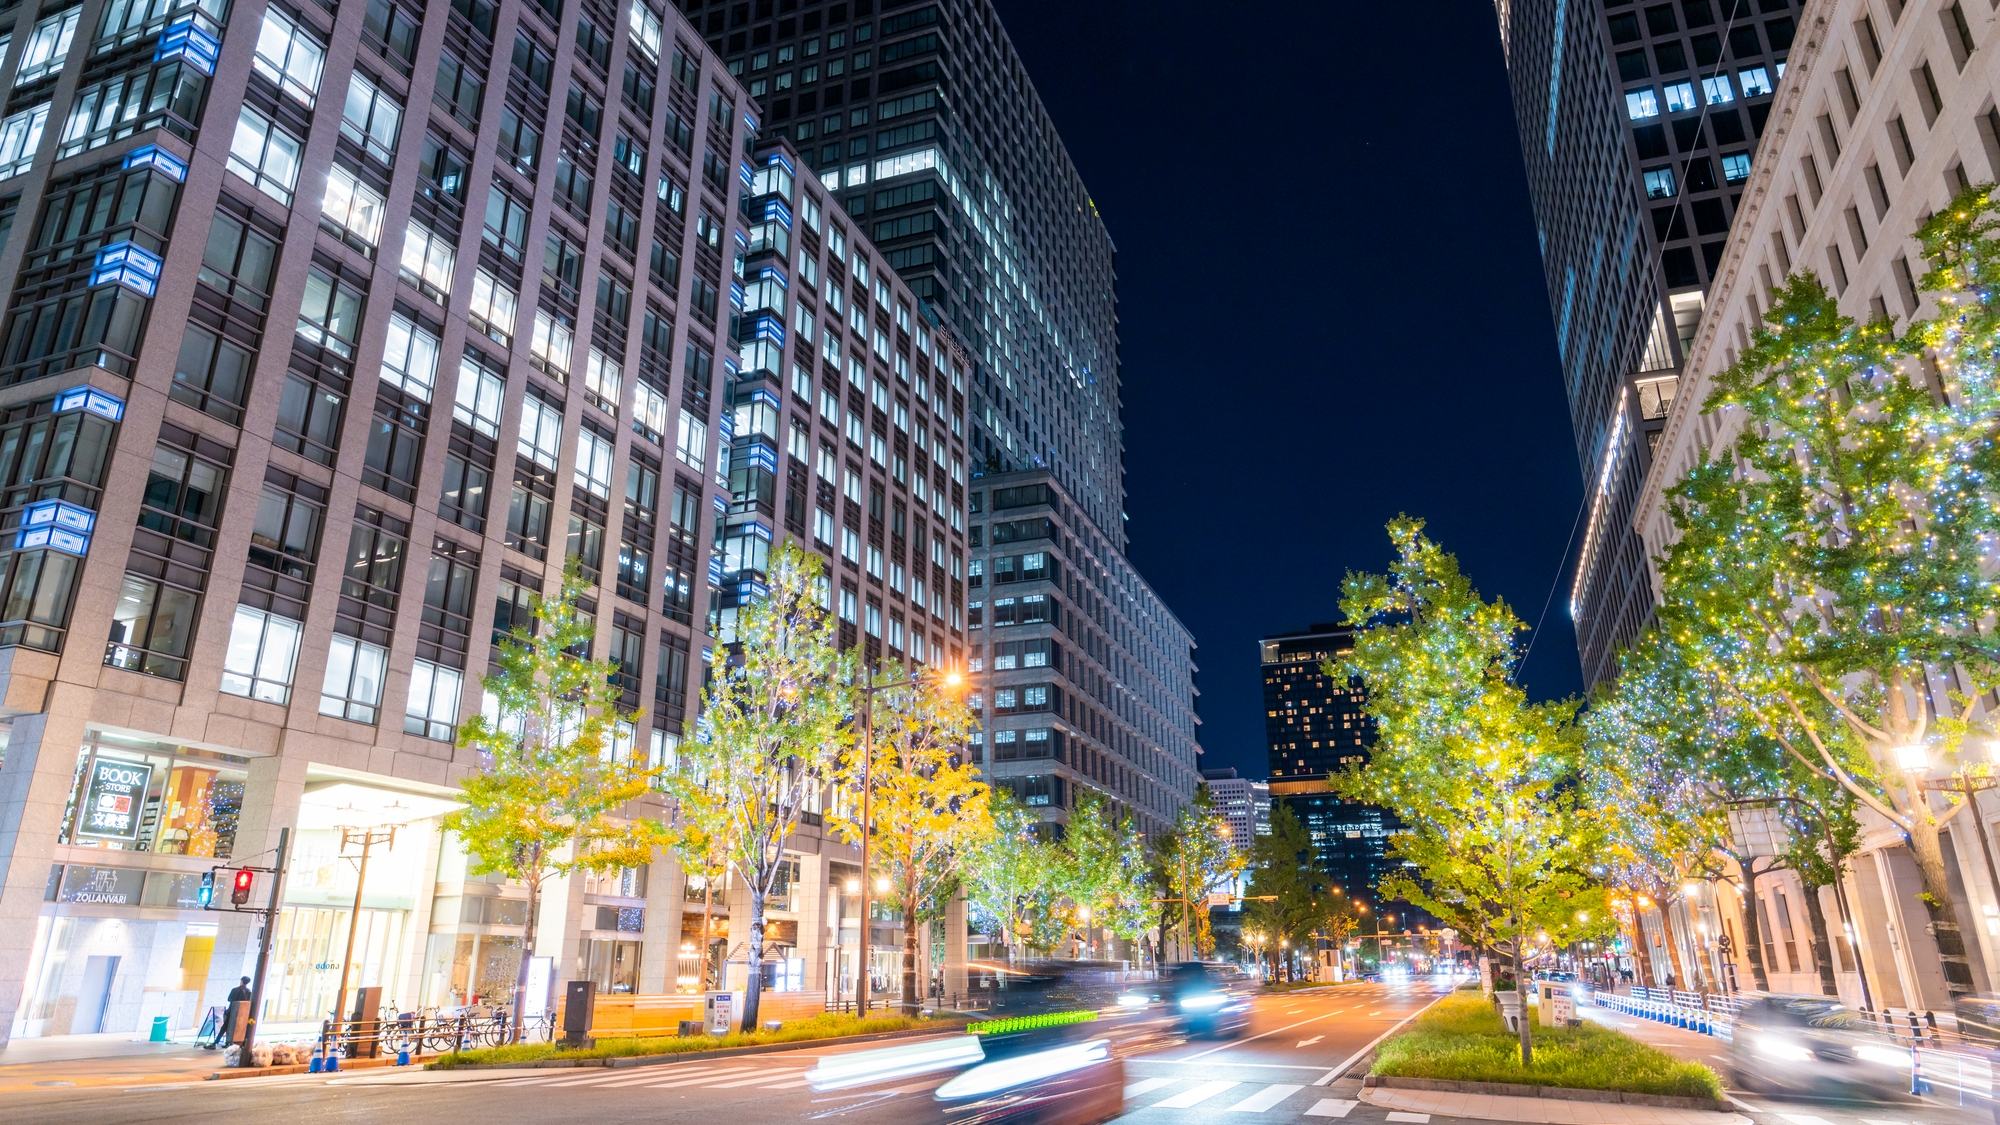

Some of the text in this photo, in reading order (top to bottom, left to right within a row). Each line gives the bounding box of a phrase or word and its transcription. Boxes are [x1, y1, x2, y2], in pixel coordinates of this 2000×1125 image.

[99, 766, 143, 786] BOOK
[105, 782, 131, 793] STORE
[75, 893, 127, 904] ZOLLANVARI
